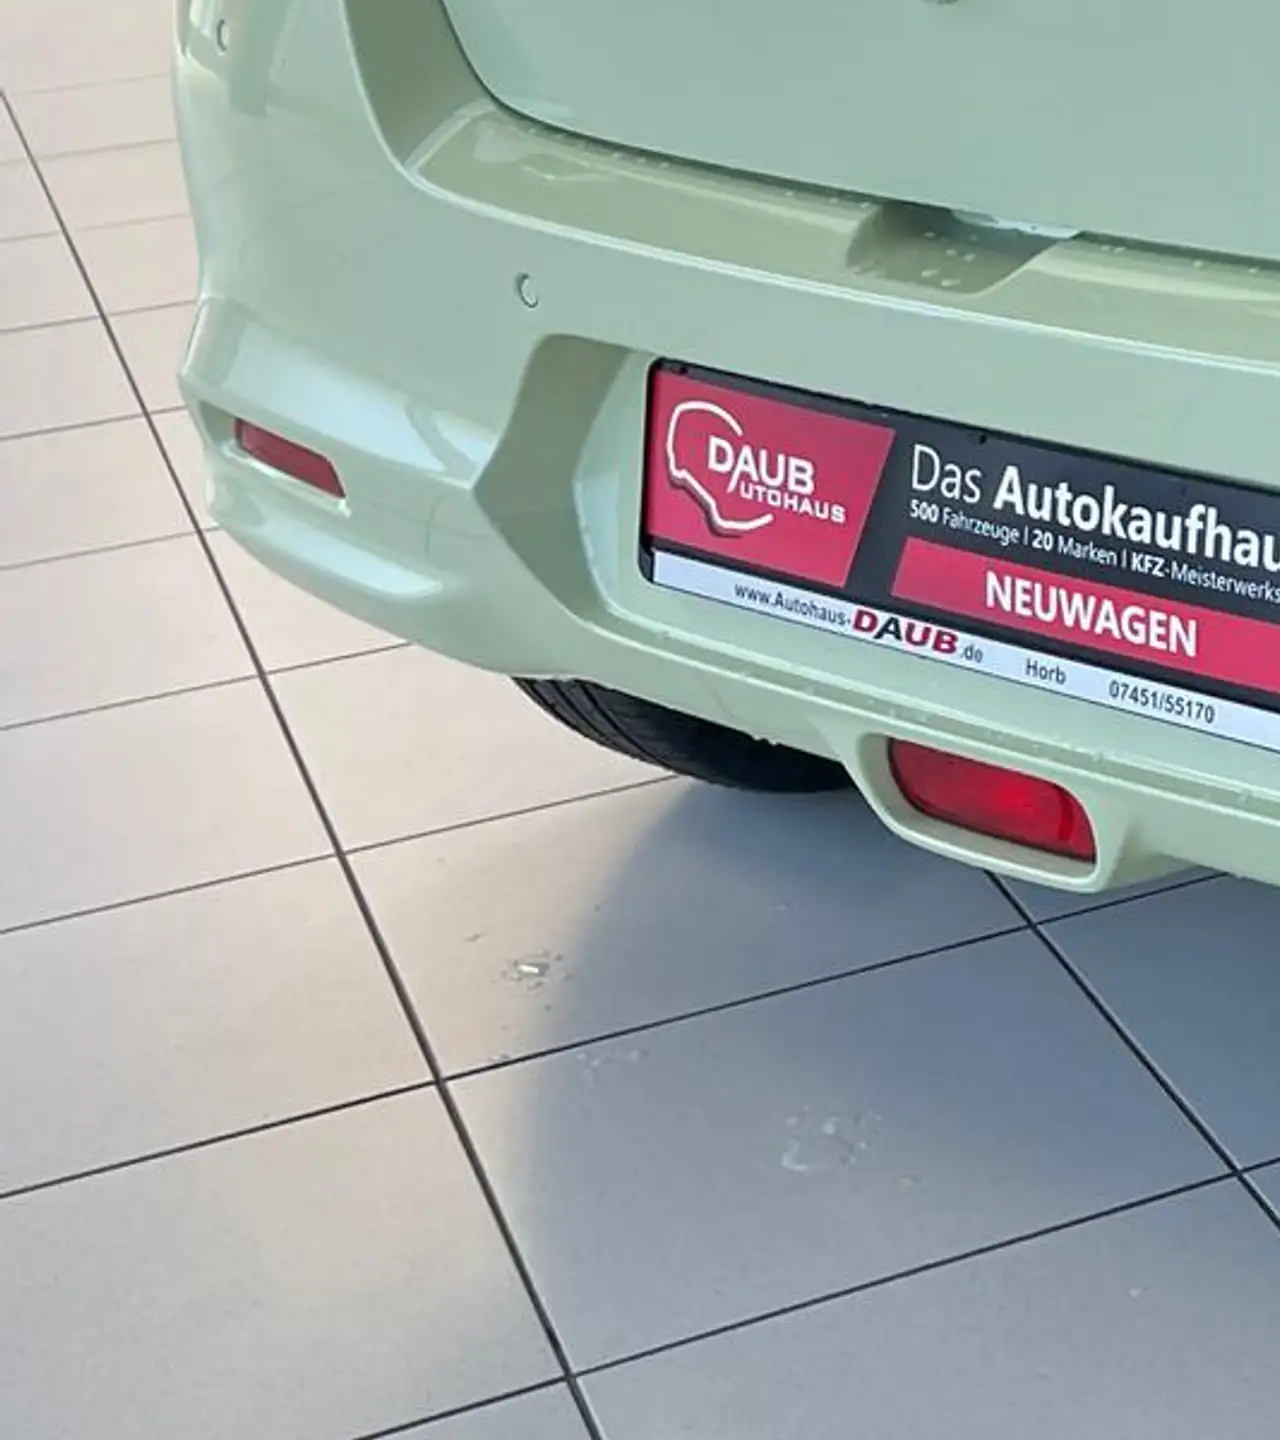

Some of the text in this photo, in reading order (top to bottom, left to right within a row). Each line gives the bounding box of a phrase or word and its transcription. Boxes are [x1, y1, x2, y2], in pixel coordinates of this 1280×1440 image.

[707, 434, 815, 496] DAUB
[911, 443, 983, 504] Das
[909, 498, 939, 524] 500
[942, 507, 1021, 547] Fahrzeuge
[1031, 529, 1054, 552] 20
[1056, 534, 1118, 568] Marken
[985, 570, 1198, 658] NEUWAGEN
[1025, 658, 1067, 686] Horb
[1108, 679, 1216, 725] 07451/55170
